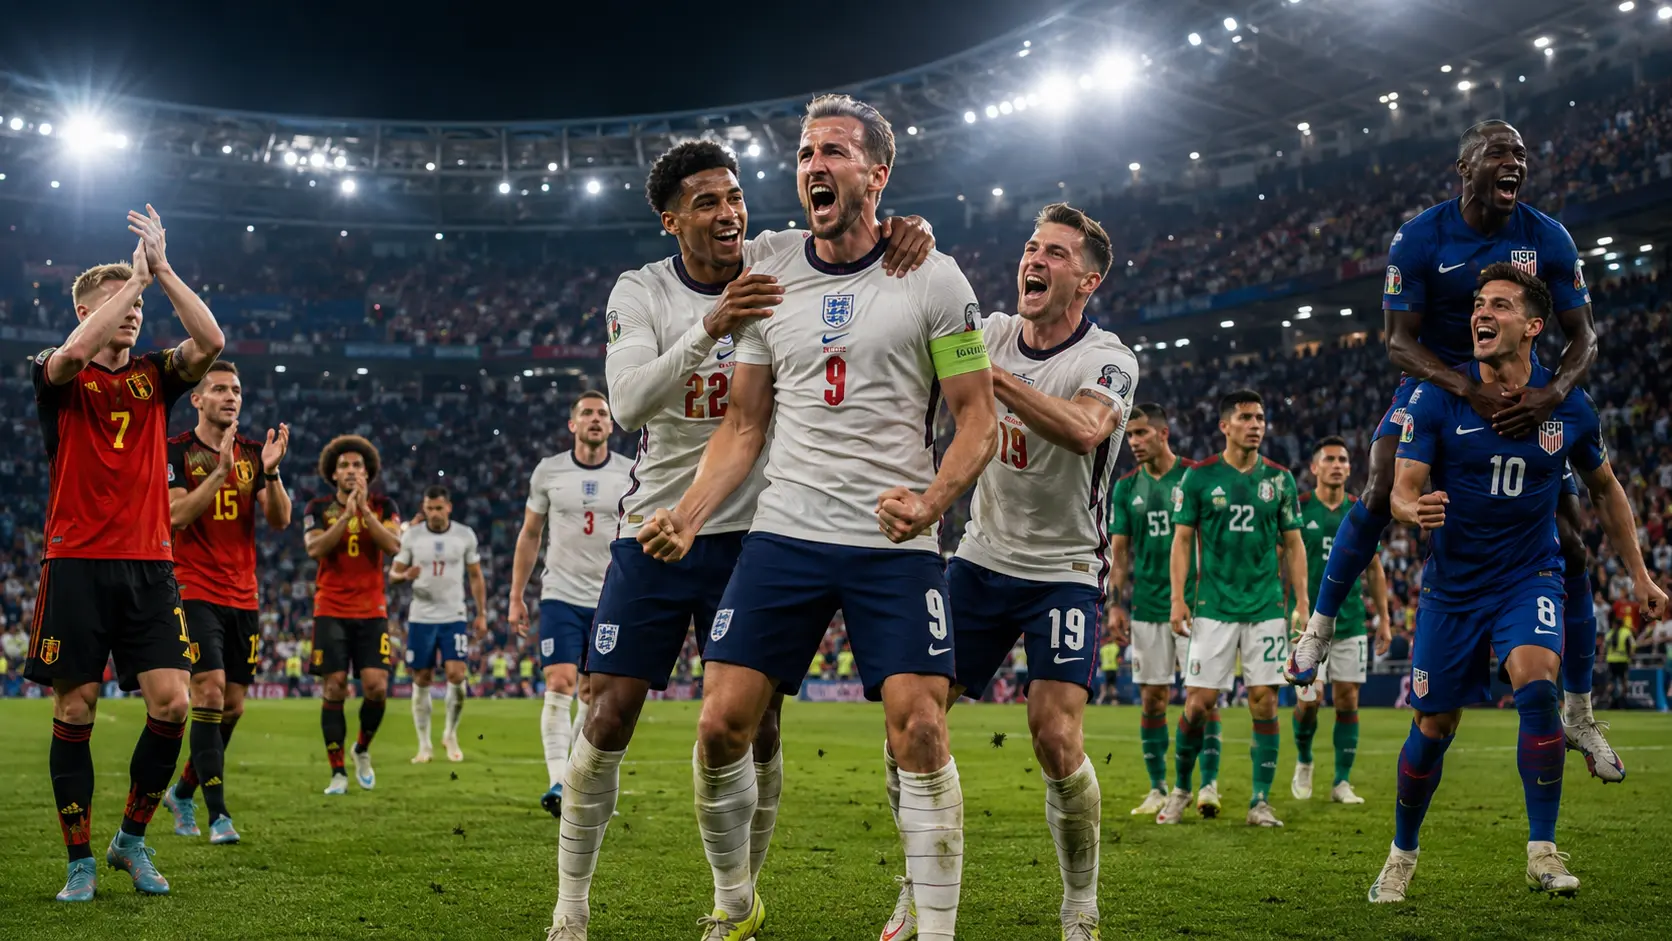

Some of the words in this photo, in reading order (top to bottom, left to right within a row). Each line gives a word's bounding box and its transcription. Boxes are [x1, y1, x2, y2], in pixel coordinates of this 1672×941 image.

[684, 371, 729, 419] 22
[823, 355, 847, 407] 9
[111, 411, 130, 449] 7
[999, 421, 1028, 470] 19
[1490, 455, 1526, 497] 10
[213, 490, 239, 520] 15
[1229, 504, 1255, 532] 22
[583, 510, 594, 535] 3
[1147, 510, 1170, 537] 53
[347, 534, 359, 557] 6
[1322, 536, 1335, 560] 5
[432, 560, 445, 576] 17
[925, 588, 948, 640] 9
[1537, 595, 1557, 628] 8
[380, 632, 391, 656] 6
[1048, 608, 1086, 651] 19
[1263, 636, 1287, 662] 22
